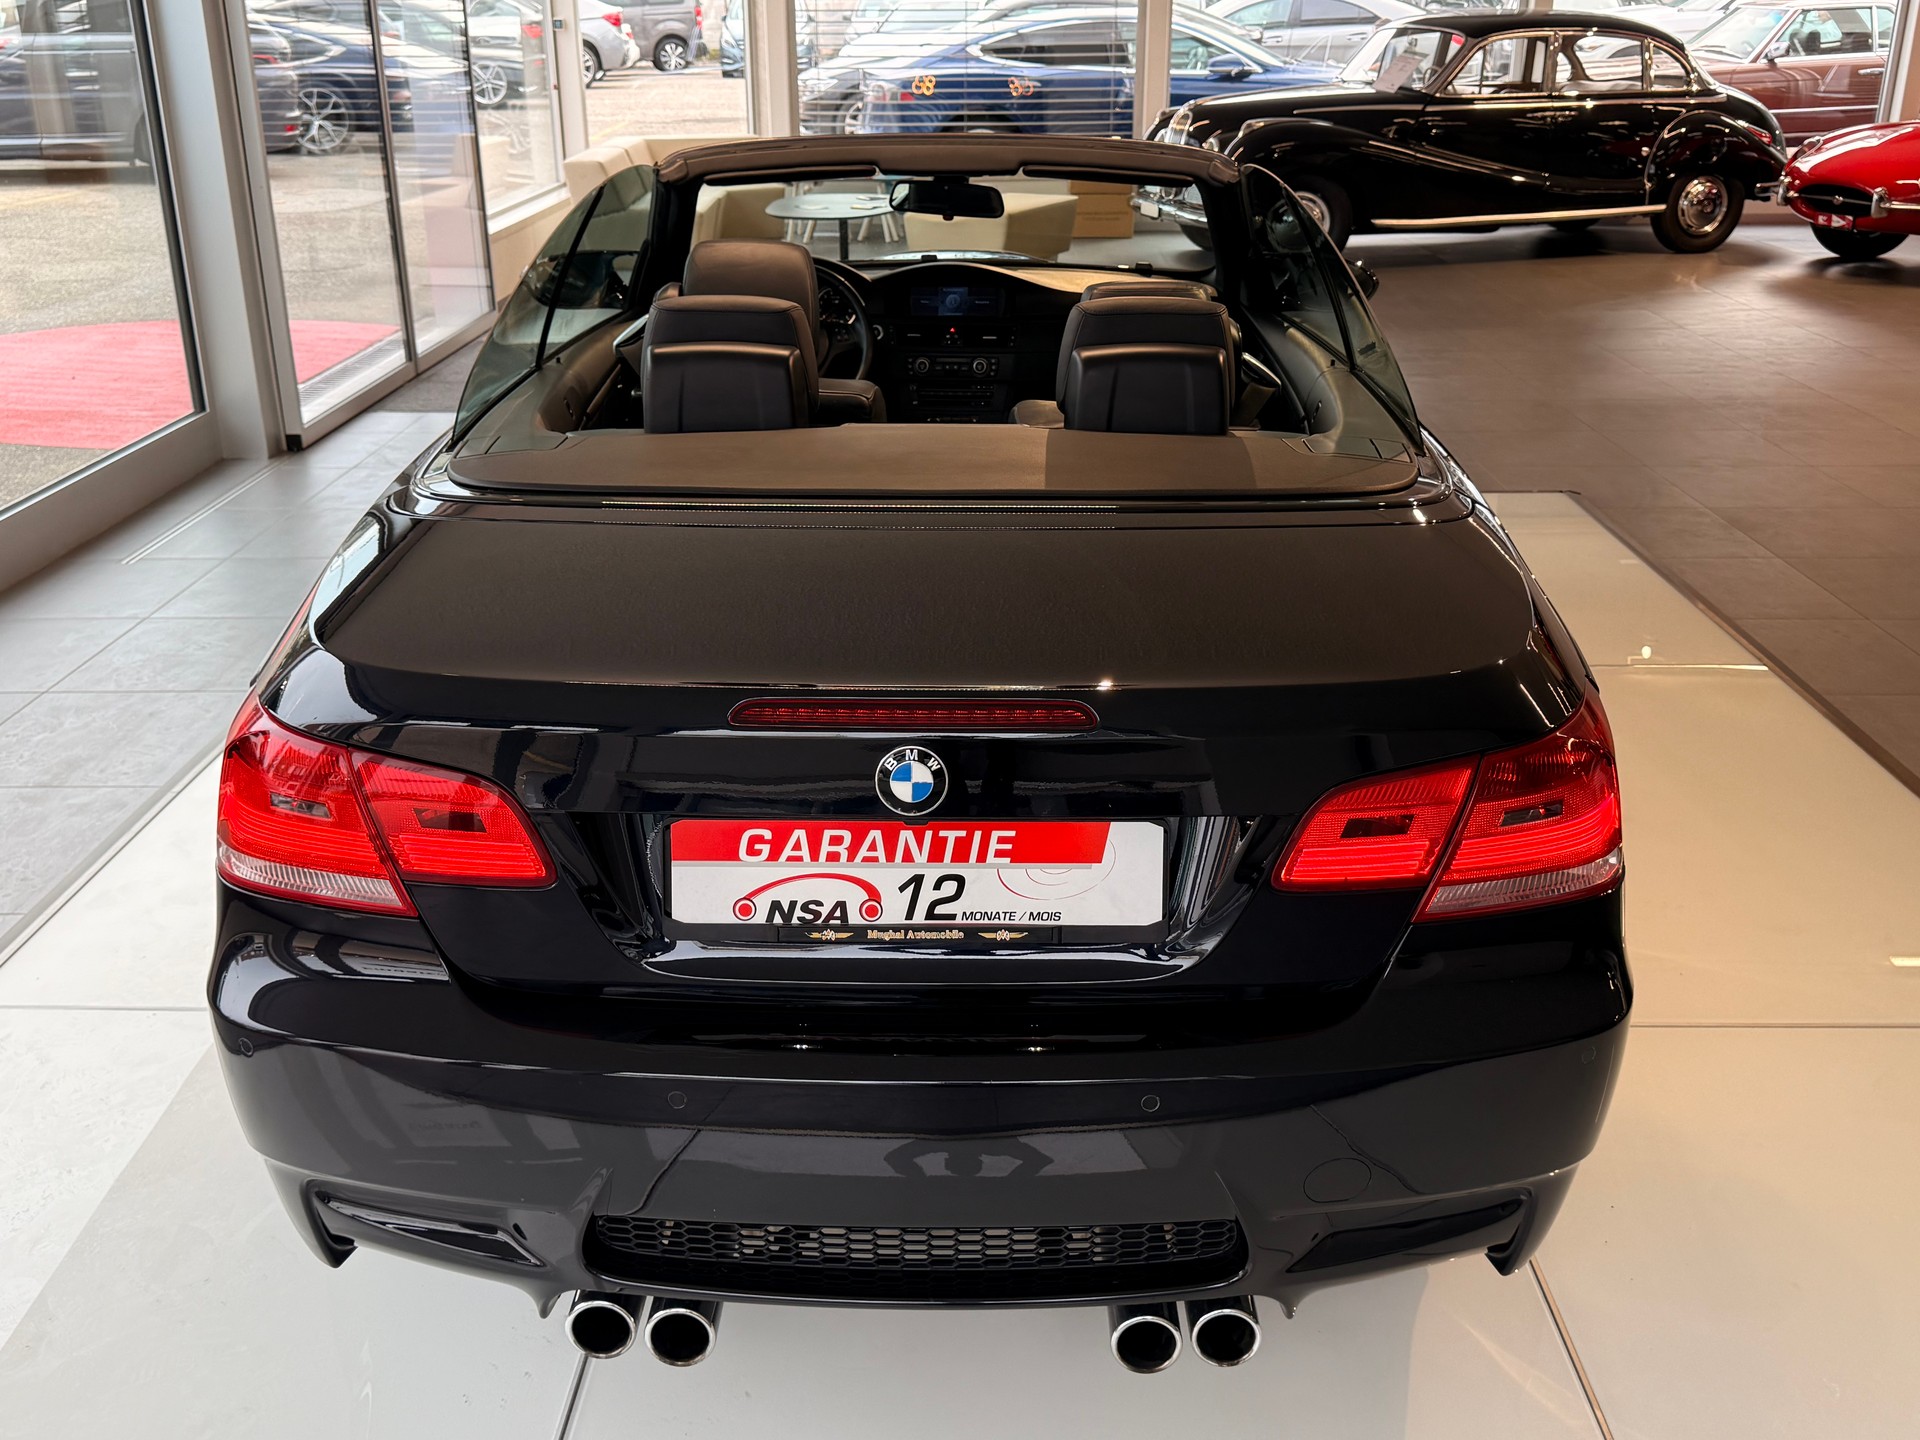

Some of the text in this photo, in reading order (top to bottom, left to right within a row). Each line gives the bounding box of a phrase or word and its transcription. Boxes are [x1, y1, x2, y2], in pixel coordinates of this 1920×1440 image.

[884, 749, 941, 772] BMW
[738, 828, 1016, 863] GARANTIE
[897, 873, 966, 921] 12
[961, 911, 1017, 922] MONATE
[1028, 911, 1062, 922] MOIS
[765, 899, 849, 925] NSA
[867, 929, 965, 941] Mughal Automobile
